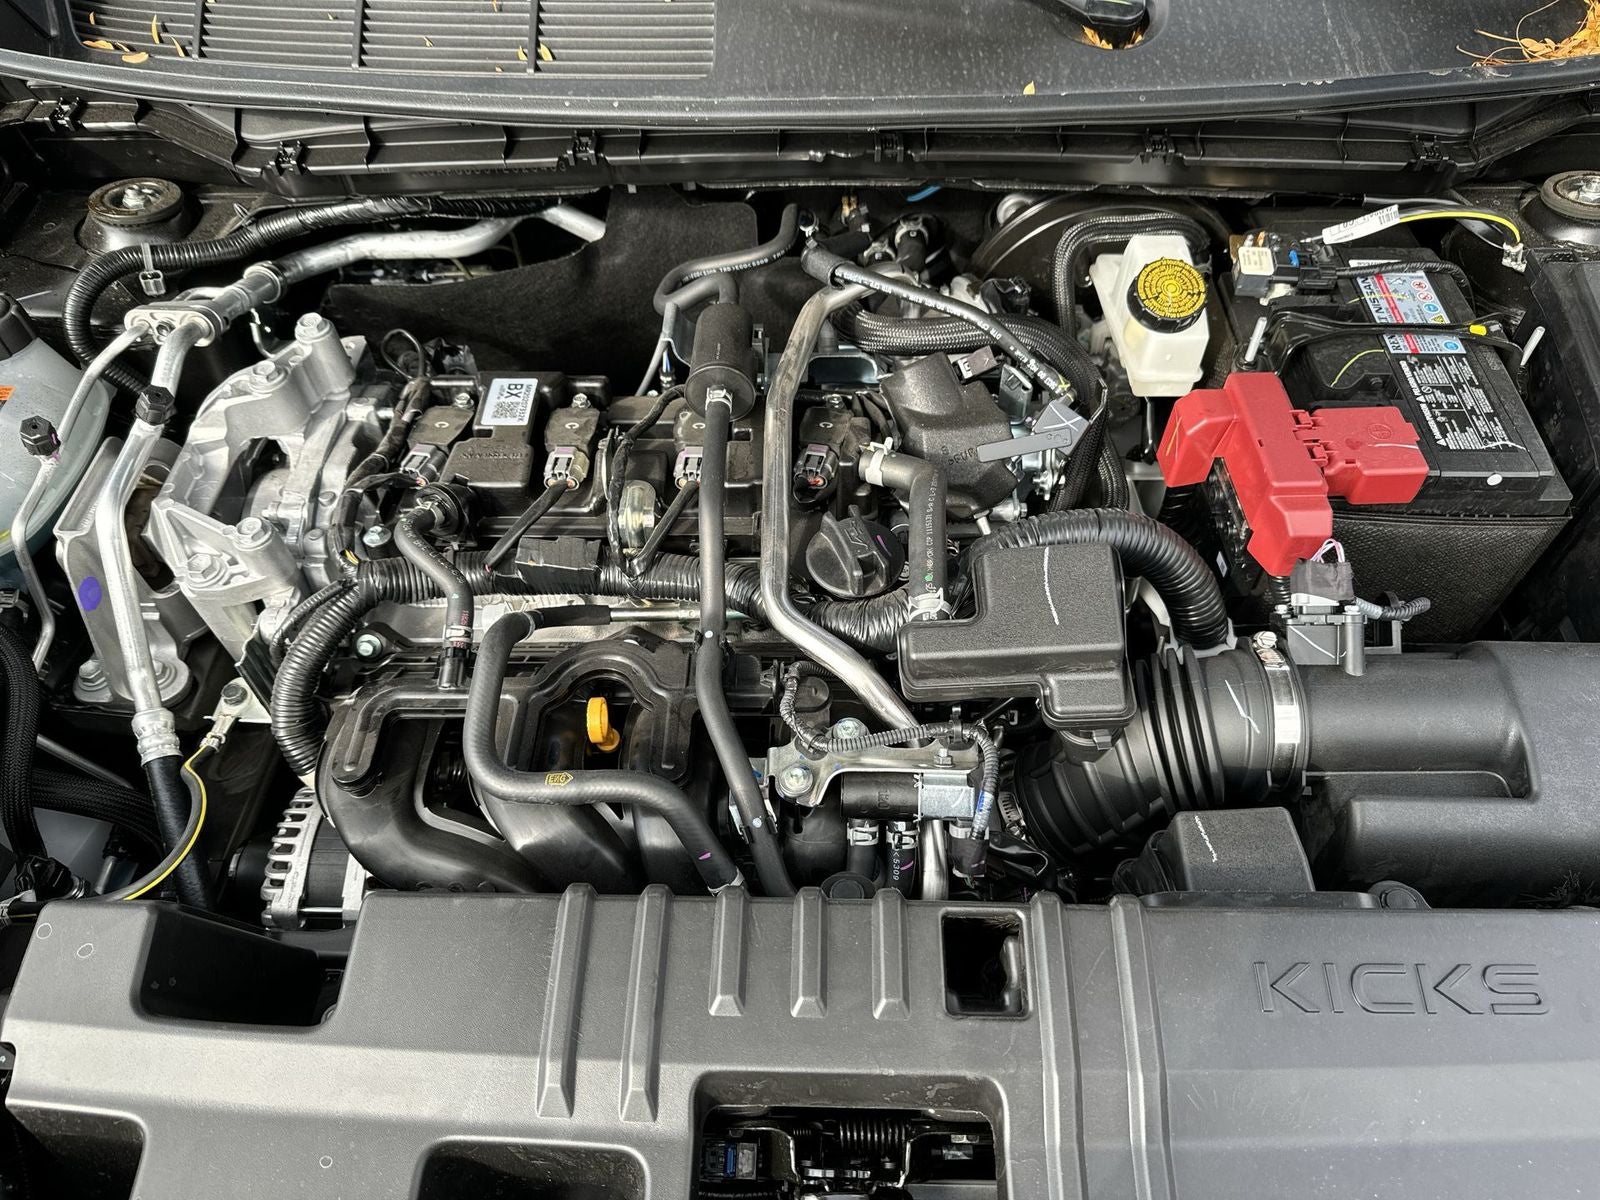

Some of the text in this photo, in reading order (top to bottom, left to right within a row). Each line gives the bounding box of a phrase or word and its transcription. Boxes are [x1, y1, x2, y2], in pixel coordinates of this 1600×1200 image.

[1360, 277, 1385, 314] NISSAN
[507, 382, 524, 399] BX
[1252, 961, 1550, 1016] KICKS
